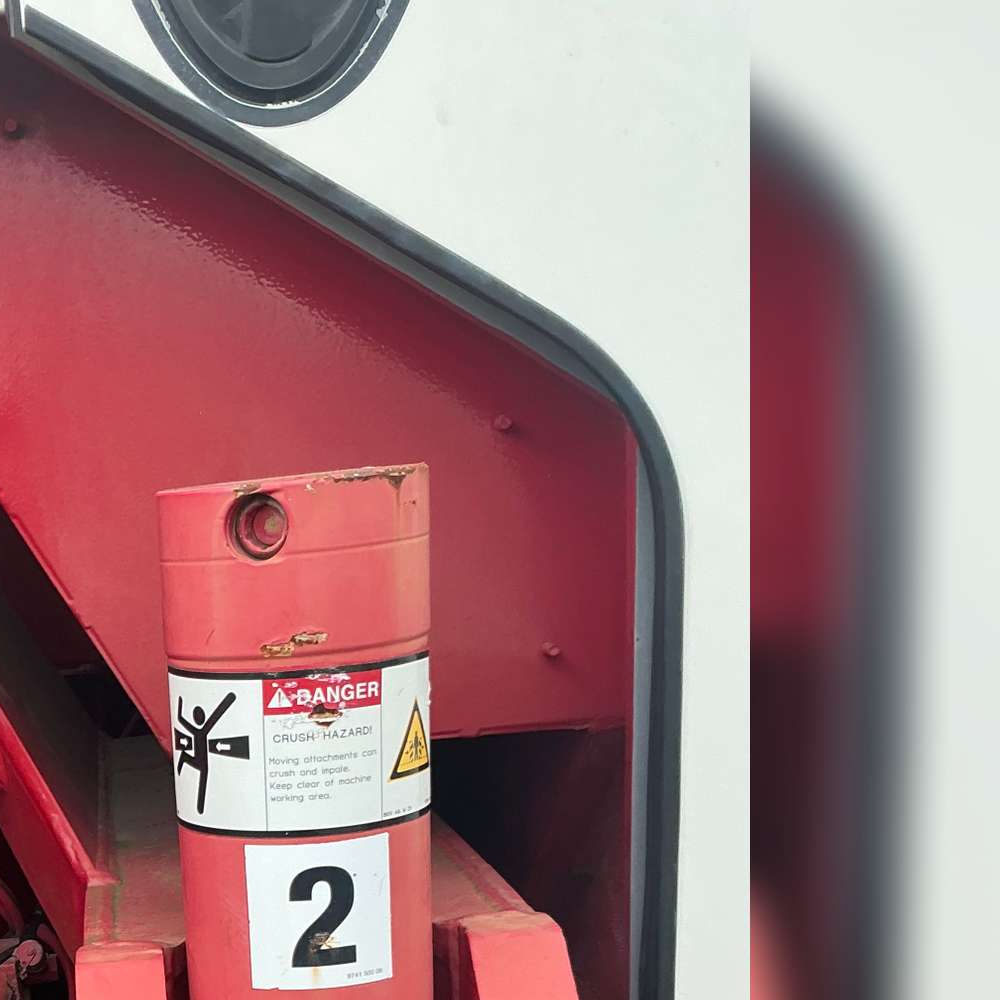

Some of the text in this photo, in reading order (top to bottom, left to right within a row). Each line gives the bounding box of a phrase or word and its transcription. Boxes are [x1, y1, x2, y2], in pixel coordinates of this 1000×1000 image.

[296, 681, 379, 706] DANGER
[272, 726, 373, 743] CRUSH HAZARD!
[268, 749, 377, 766] Moving attachments can
[269, 769, 296, 778] crush
[300, 768, 318, 777] and
[269, 775, 372, 791] Keep clear of machine
[270, 793, 304, 803] working
[288, 865, 357, 968] 2
